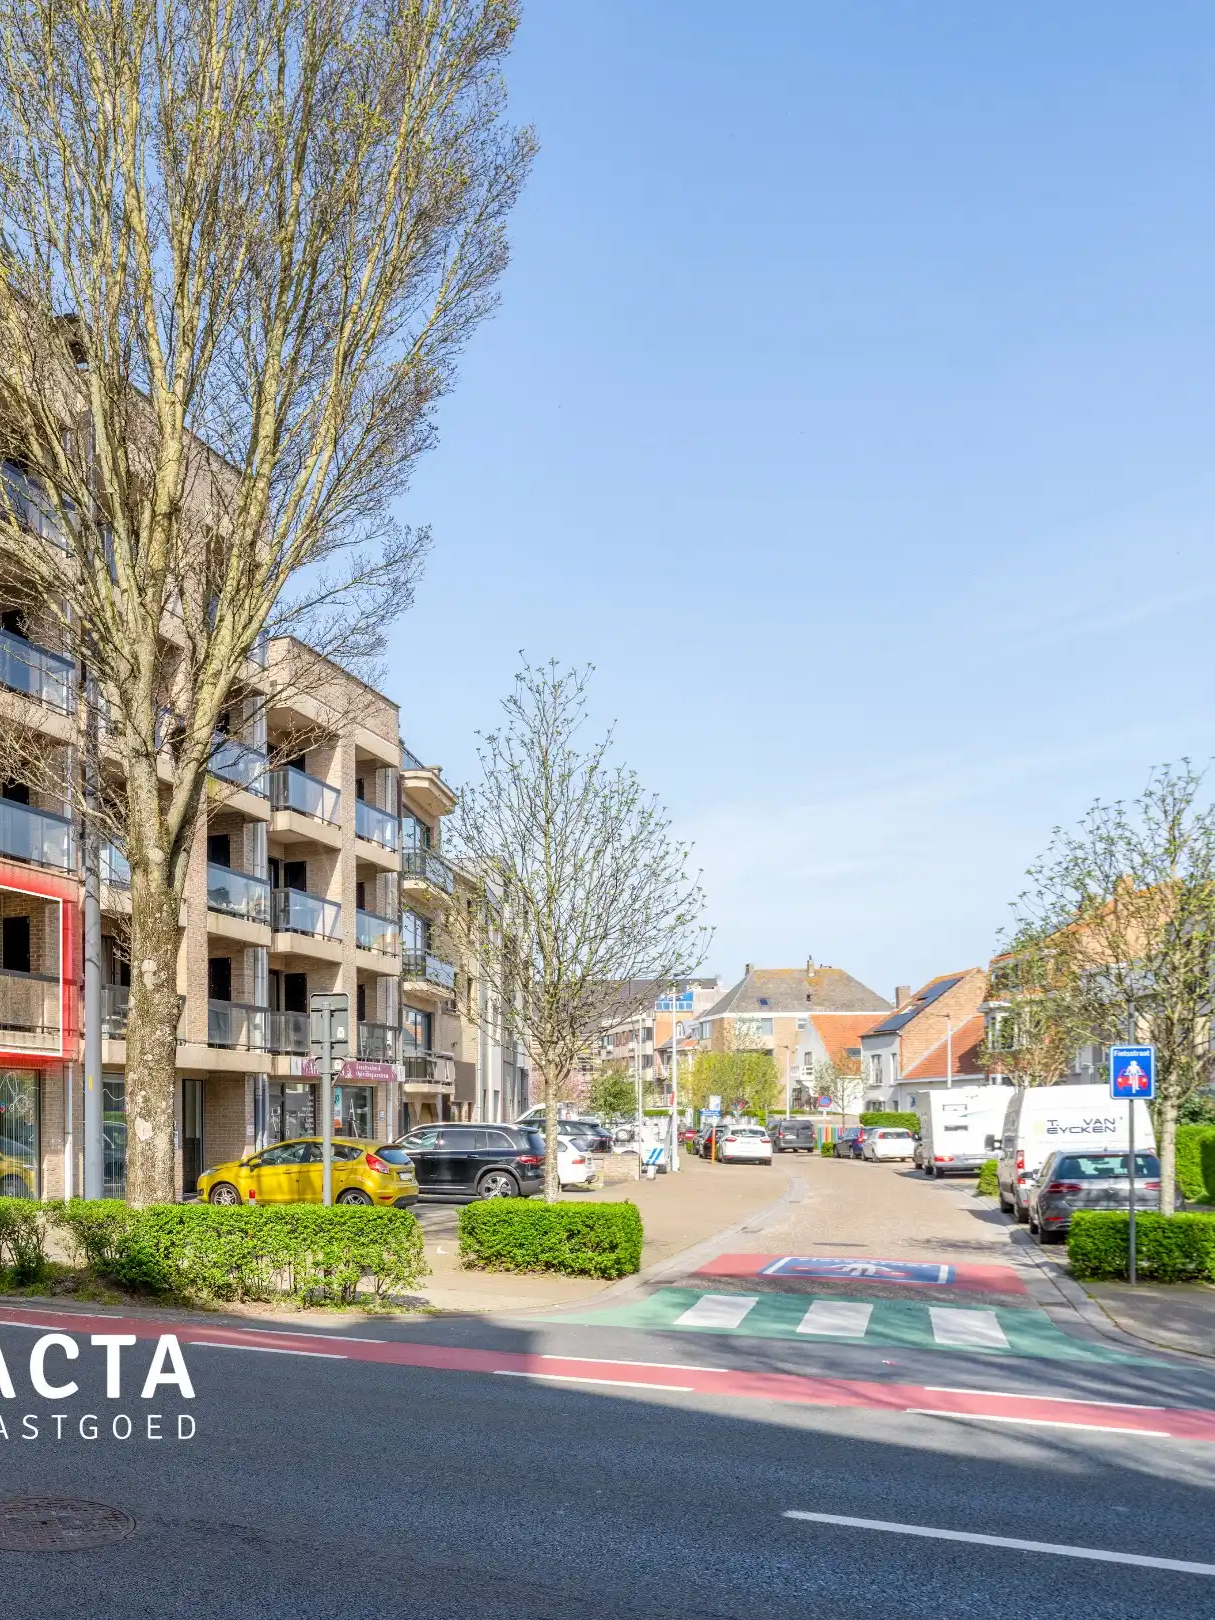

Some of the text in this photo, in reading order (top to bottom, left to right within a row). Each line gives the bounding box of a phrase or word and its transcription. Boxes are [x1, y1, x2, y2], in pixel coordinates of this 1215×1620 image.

[1047, 1118, 1115, 1127] T. VAN
[1047, 1126, 1116, 1135] EYCKEN
